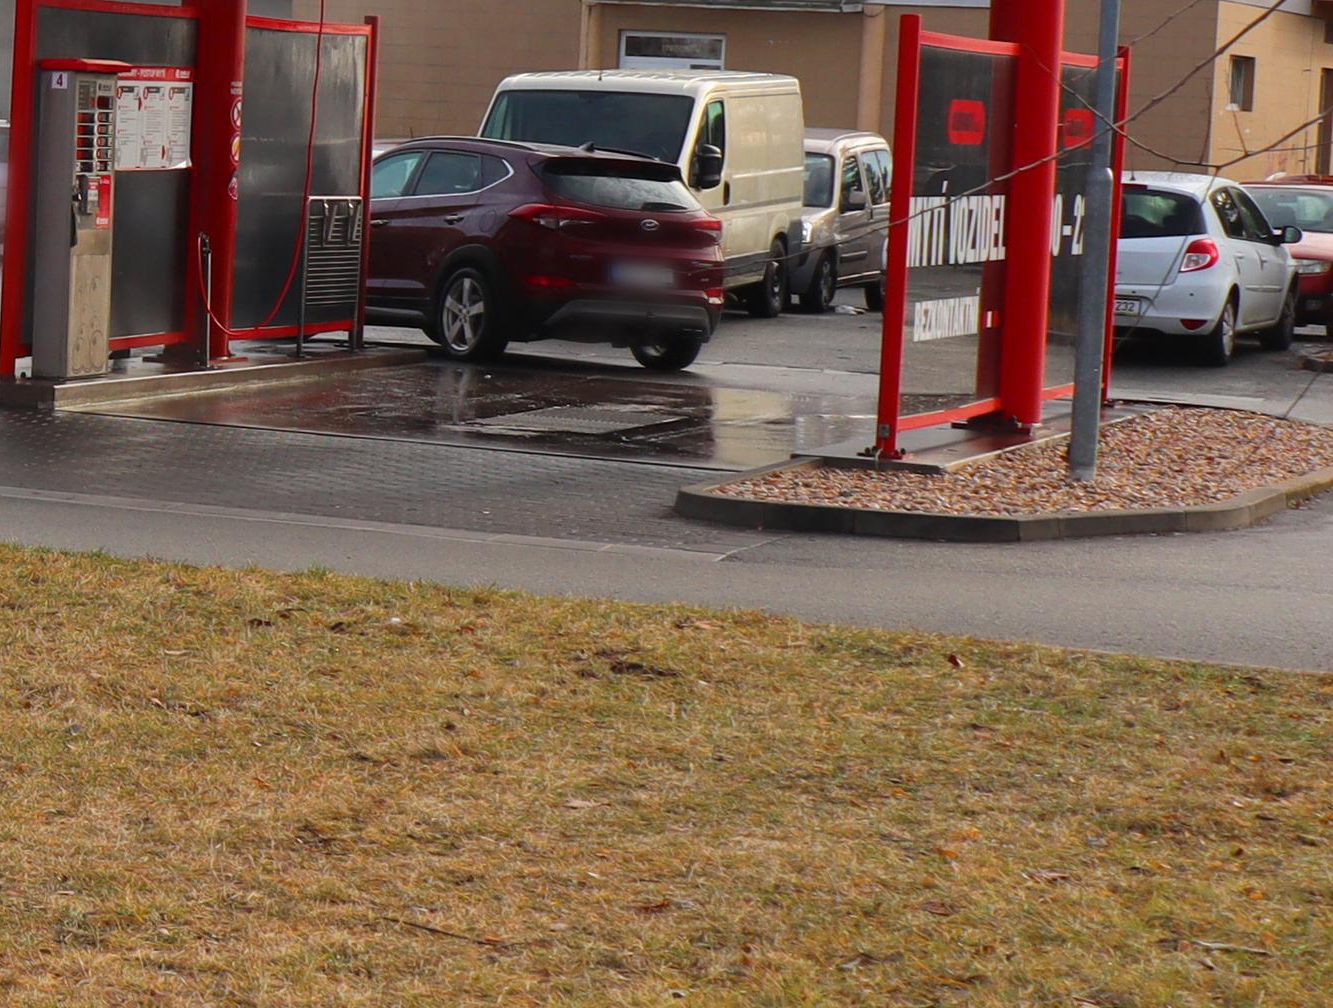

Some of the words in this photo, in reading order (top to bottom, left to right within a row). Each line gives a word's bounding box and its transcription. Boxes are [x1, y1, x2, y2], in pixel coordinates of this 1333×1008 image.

[56, 73, 63, 87] 4
[906, 180, 948, 268] MYTÍ
[949, 194, 1006, 265] VOZIDEL
